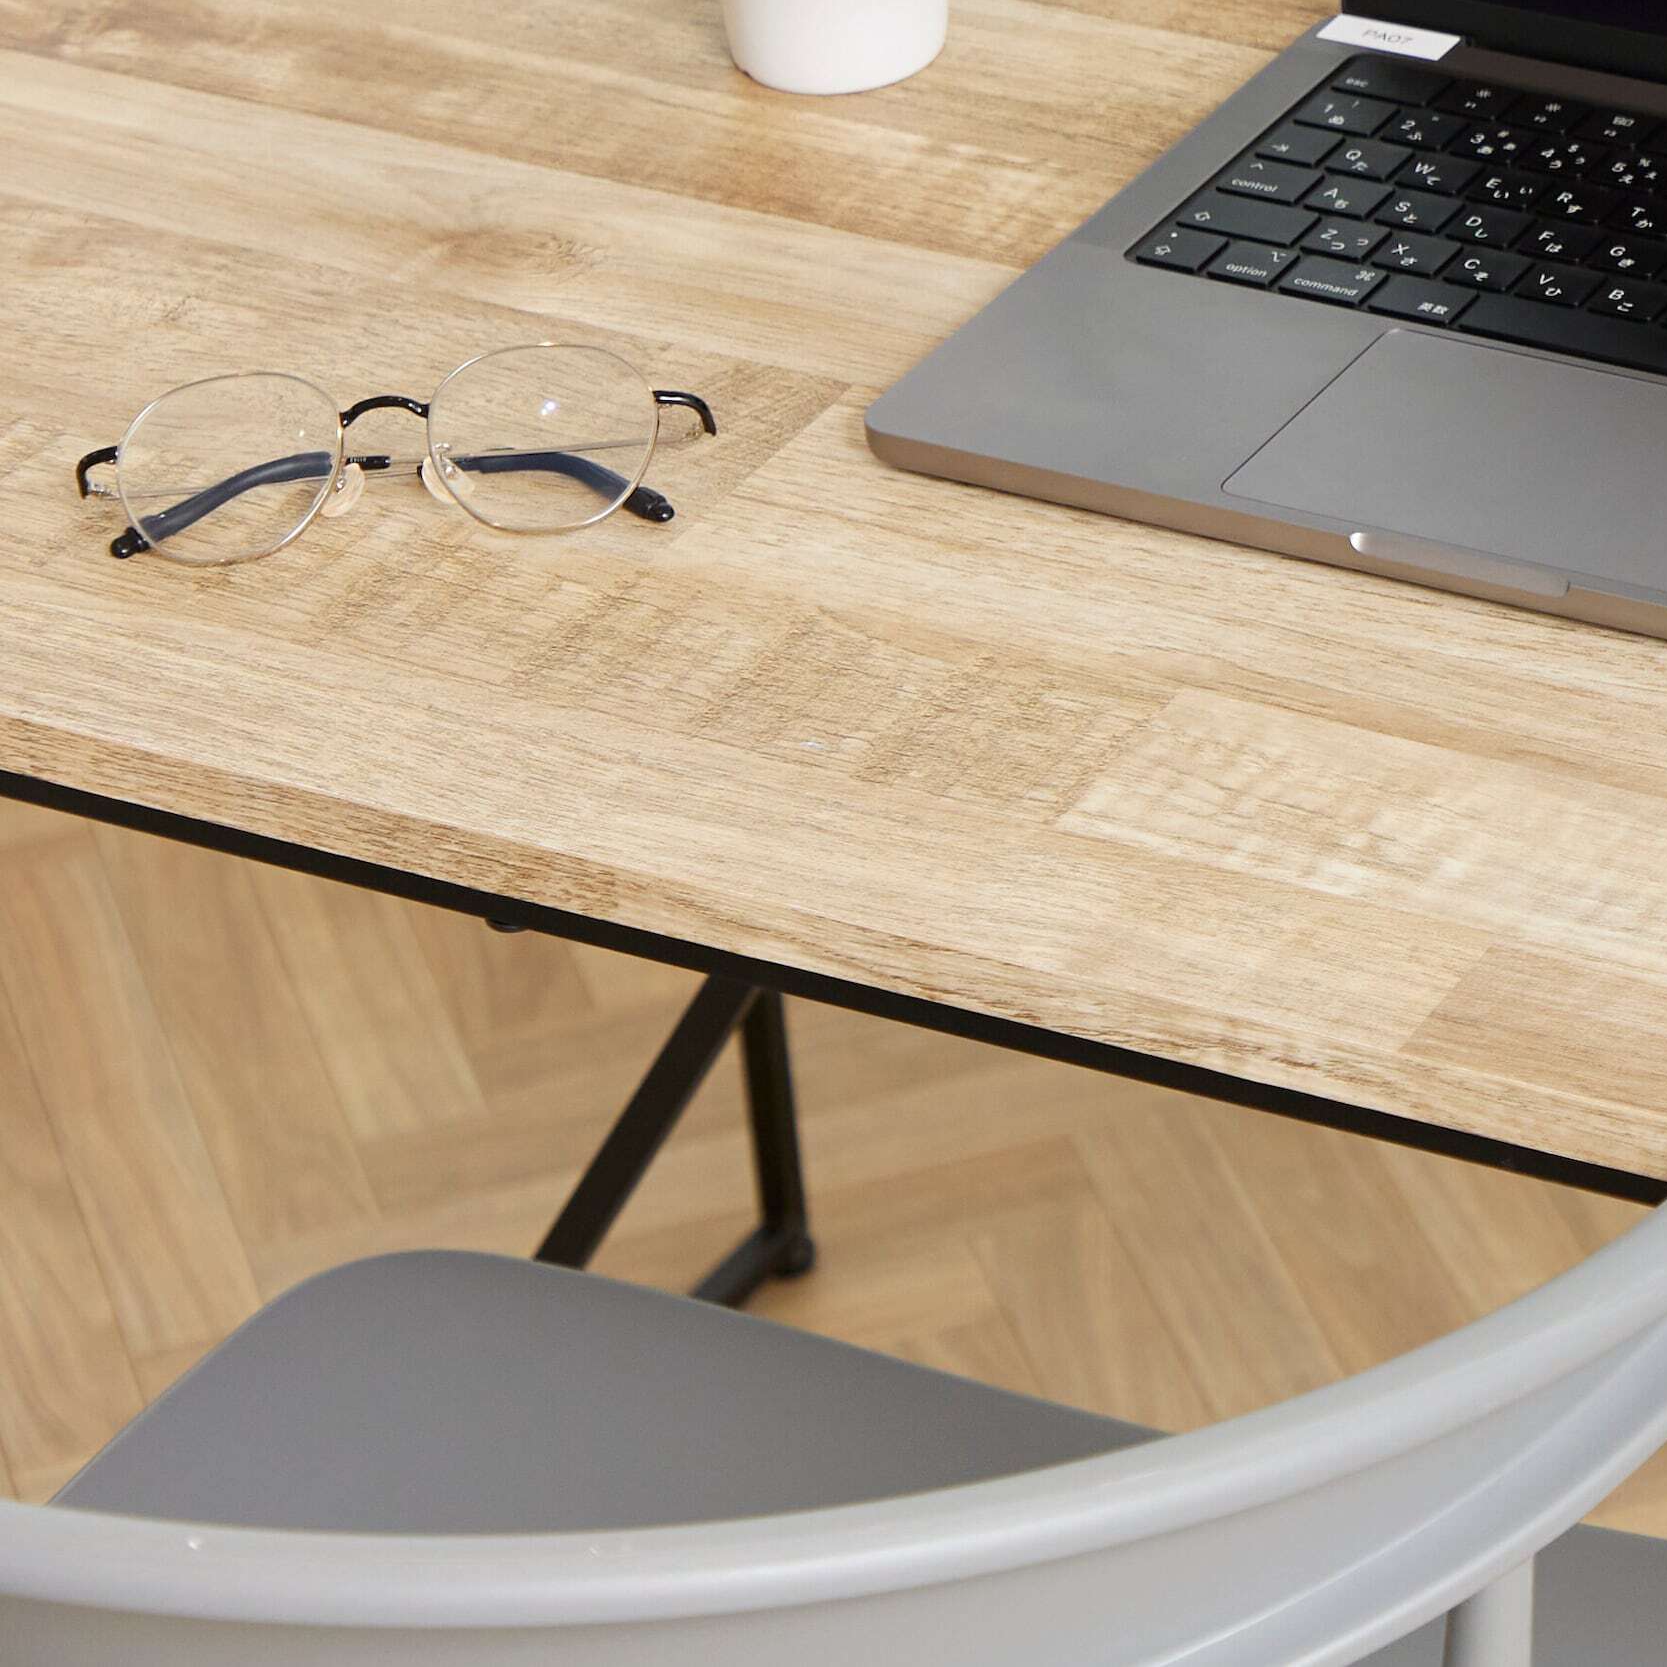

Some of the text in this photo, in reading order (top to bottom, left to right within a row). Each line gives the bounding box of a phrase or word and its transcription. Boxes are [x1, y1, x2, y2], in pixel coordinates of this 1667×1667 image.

[1231, 177, 1279, 193] control
[1225, 262, 1268, 279] option
[1293, 277, 1359, 298] command
